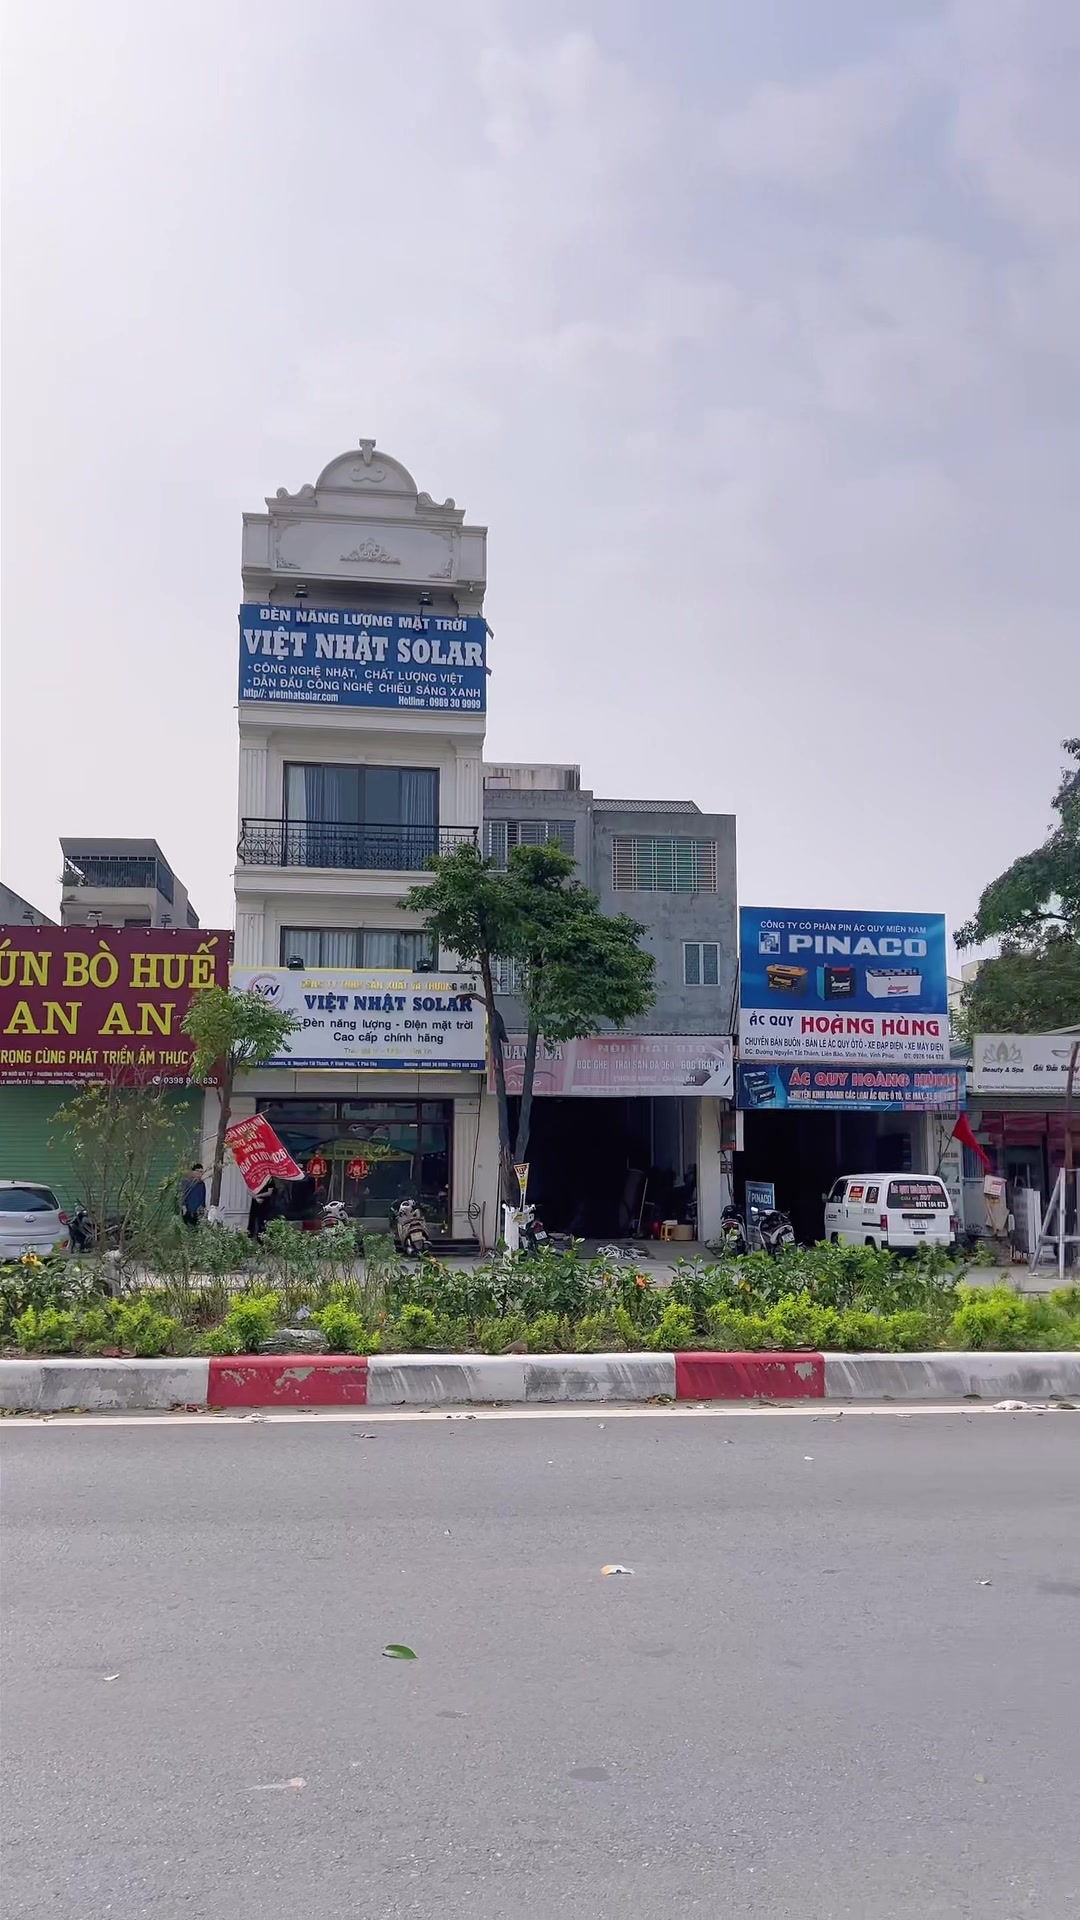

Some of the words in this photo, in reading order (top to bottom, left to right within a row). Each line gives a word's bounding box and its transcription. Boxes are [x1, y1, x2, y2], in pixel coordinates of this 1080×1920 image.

[260, 607, 291, 621] ĐÈN
[296, 609, 339, 624] NĂNG
[344, 613, 393, 628] LƯỢNG
[398, 616, 430, 631] MẶT
[435, 618, 467, 632] TRỜI
[243, 626, 307, 661] VIỆT
[315, 631, 389, 666] NHẬT
[397, 638, 484, 667] SOLAR
[253, 663, 287, 674] CÔNG
[290, 665, 321, 679] NGHỆ
[326, 666, 358, 680] NHẬT,
[364, 668, 394, 680] CHẤT
[398, 671, 437, 683] LƯỢNG
[440, 673, 464, 686] VIỆT
[269, 689, 339, 702] vietnhatsolar.com
[307, 679, 340, 691] CÔNG
[343, 682, 374, 695] NGHỆ
[378, 681, 411, 694] CHIẾU
[416, 684, 447, 696] SÁNG
[450, 687, 481, 698] XANH
[429, 697, 449, 708] 0989
[449, 698, 460, 708] 30
[461, 699, 481, 709] 9999
[760, 920, 785, 929] CÔNG
[838, 923, 852, 931] PIN
[908, 926, 927, 934] NAM
[788, 934, 927, 957] PINACO
[62, 940, 119, 988] BÒ
[129, 936, 218, 989] HUẾ
[304, 992, 349, 1013] VIỆT
[353, 993, 406, 1014] NHẬT
[412, 996, 473, 1012] SOLAR
[3, 1001, 82, 1035] AN
[98, 1002, 176, 1036] AN
[302, 1018, 325, 1028] Đèn
[330, 1019, 357, 1030] năng
[362, 1019, 392, 1030] lượng
[431, 1020, 452, 1031] mặt
[456, 1020, 473, 1030] trời
[749, 1010, 765, 1027] ẮC
[769, 1015, 794, 1028] QUY
[801, 1013, 874, 1035] HOÀNG
[882, 1015, 940, 1037] HÙNG
[333, 1032, 355, 1042] Cao
[358, 1030, 378, 1044] cấp
[383, 1032, 412, 1043] chính
[417, 1034, 444, 1044] hãng
[837, 1039, 850, 1049] QUY
[867, 1041, 876, 1050] XE
[907, 1042, 916, 1051] XE
[35, 1047, 66, 1064] CÙNG
[69, 1047, 98, 1064] PHÁT
[102, 1044, 134, 1065] TRIỂN
[138, 1044, 156, 1065] ẨM
[159, 1049, 189, 1067] THỰC
[814, 1072, 849, 1087] QUY
[851, 1070, 911, 1087] HOÀNG
[982, 1066, 1003, 1074] Beauty
[751, 1192, 772, 1204] PINACO
